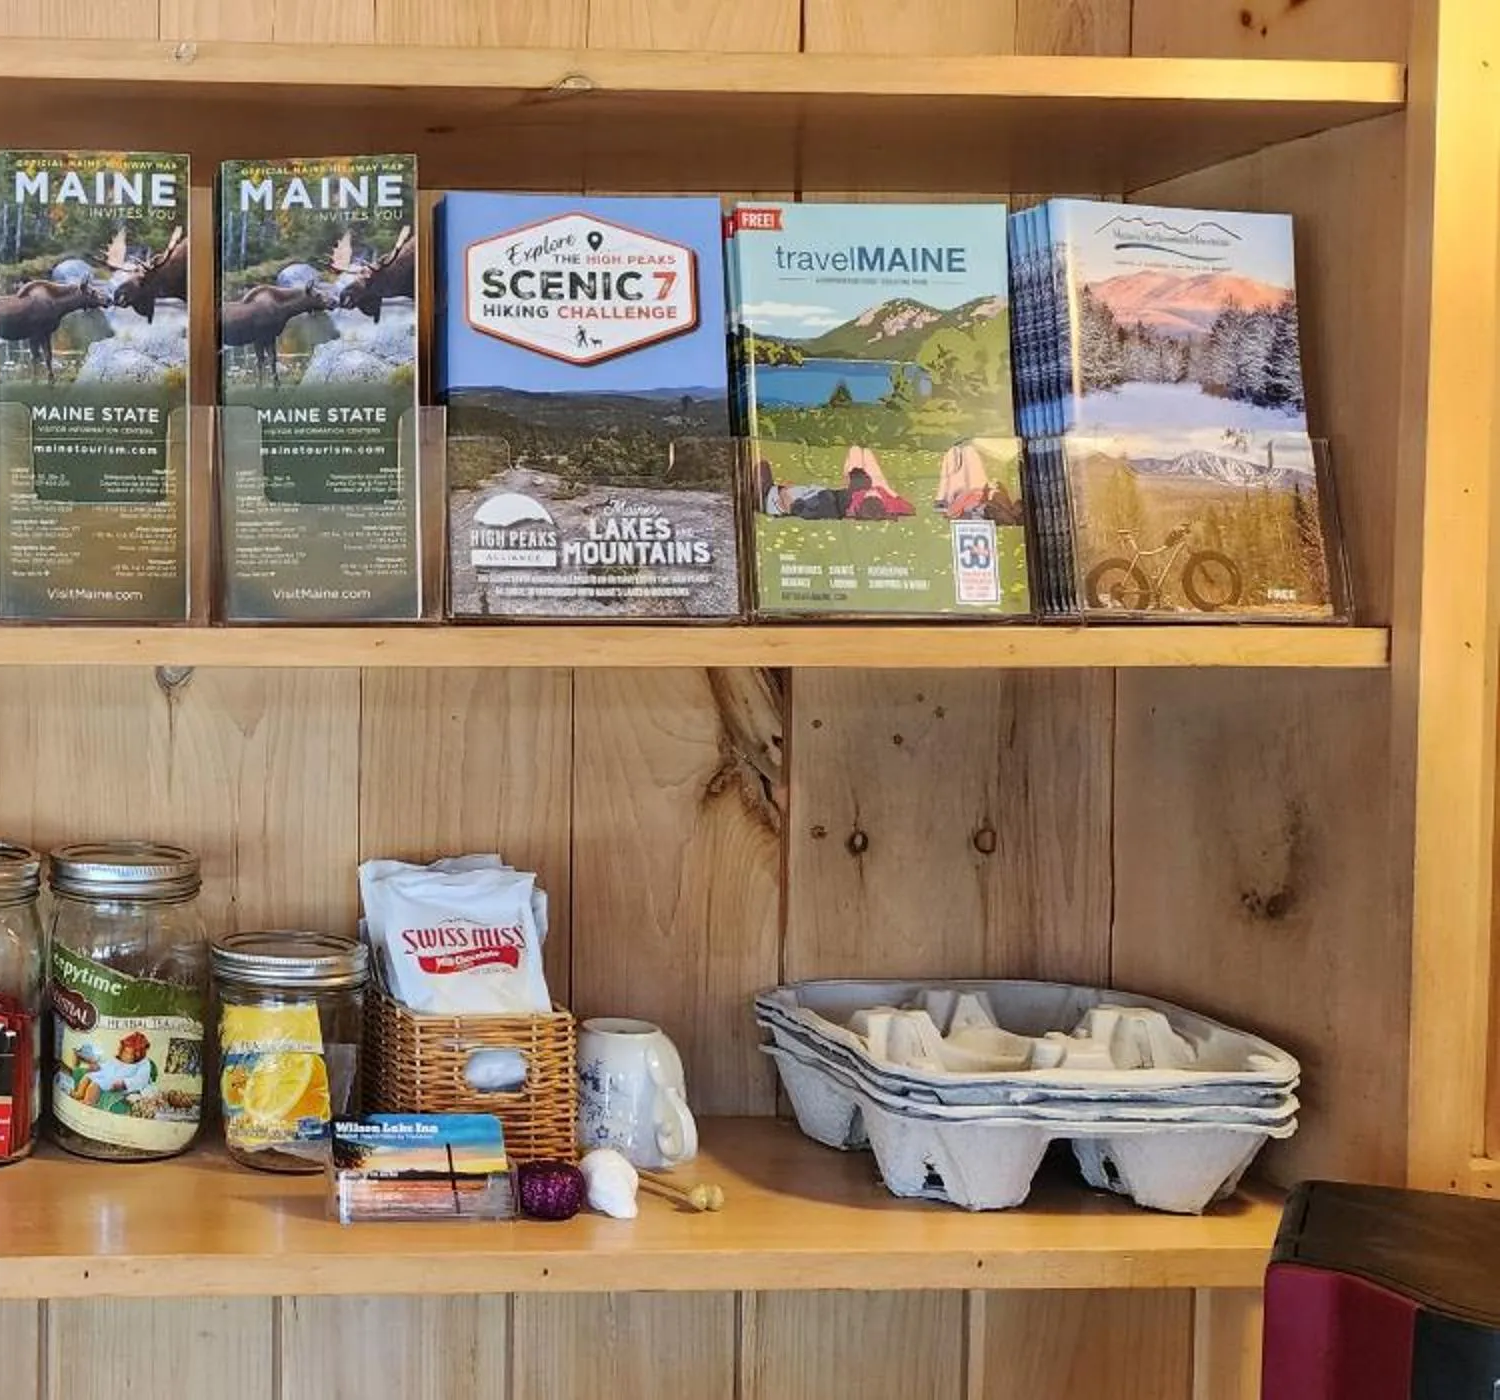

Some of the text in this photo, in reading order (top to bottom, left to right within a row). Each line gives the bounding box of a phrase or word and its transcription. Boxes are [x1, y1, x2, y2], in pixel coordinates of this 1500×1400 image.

[15, 171, 177, 207] MAINE
[240, 175, 404, 211] MAINE
[89, 207, 176, 221] INVITES YOU
[373, 209, 403, 221] YOU
[741, 213, 774, 229] FREE!
[506, 235, 576, 266] Explore
[776, 244, 967, 273] travelMAINE
[554, 254, 677, 265] THE HIGH PEAKS
[482, 269, 677, 301] SCENIC 7
[483, 304, 678, 320] HIKING CHALLENGE
[32, 406, 160, 423] MAINE STATE
[257, 407, 387, 424] MAINE STATE
[33, 443, 157, 455] mainetourism.com
[259, 444, 385, 456] mainetourism.com
[589, 517, 672, 541] LAKES
[471, 530, 557, 548] HIGH PEAKS
[563, 541, 711, 566] MOUNTAINS
[47, 587, 143, 601] VisitMaine.com
[272, 588, 371, 600] VisitMaine.com
[401, 923, 527, 955] SWISS MISS
[335, 1121, 439, 1133] Wilson Lake Inn
